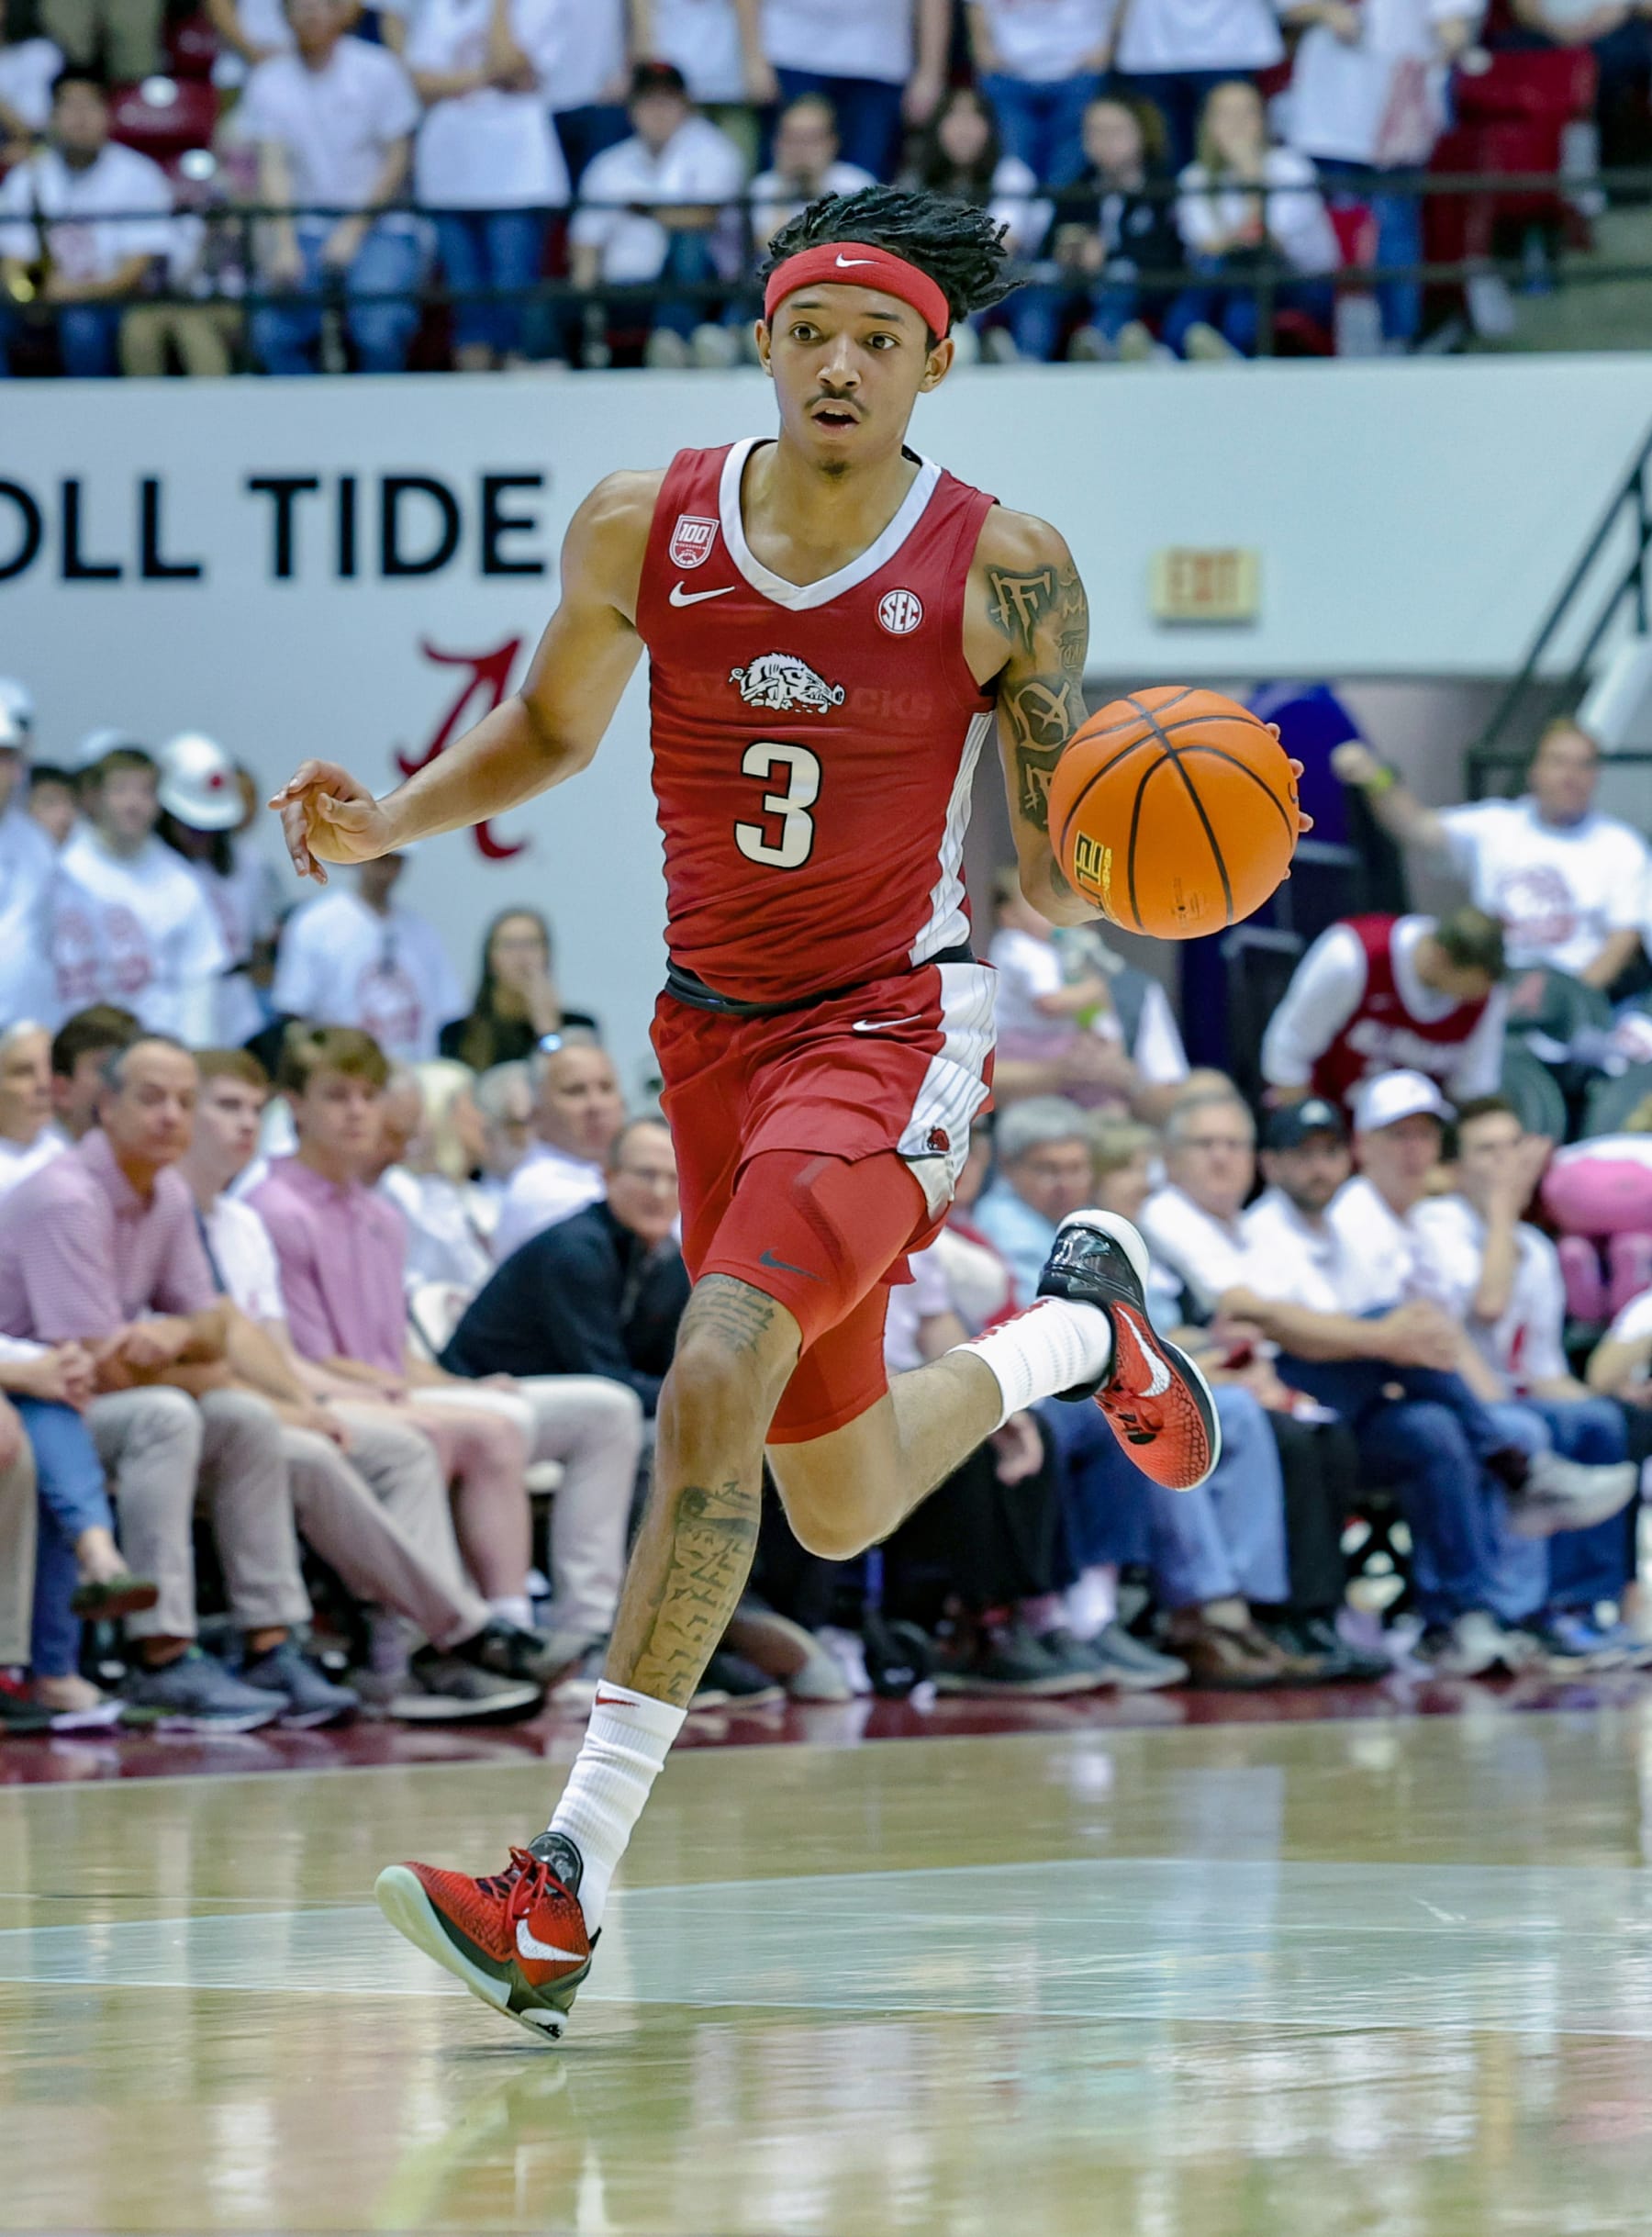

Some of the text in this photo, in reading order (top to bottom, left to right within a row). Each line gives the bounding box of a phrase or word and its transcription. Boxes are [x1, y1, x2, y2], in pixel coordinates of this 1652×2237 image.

[247, 475, 544, 578] TIDE
[678, 523, 710, 543] 100
[881, 592, 921, 632] SEC
[734, 739, 822, 870] 3
